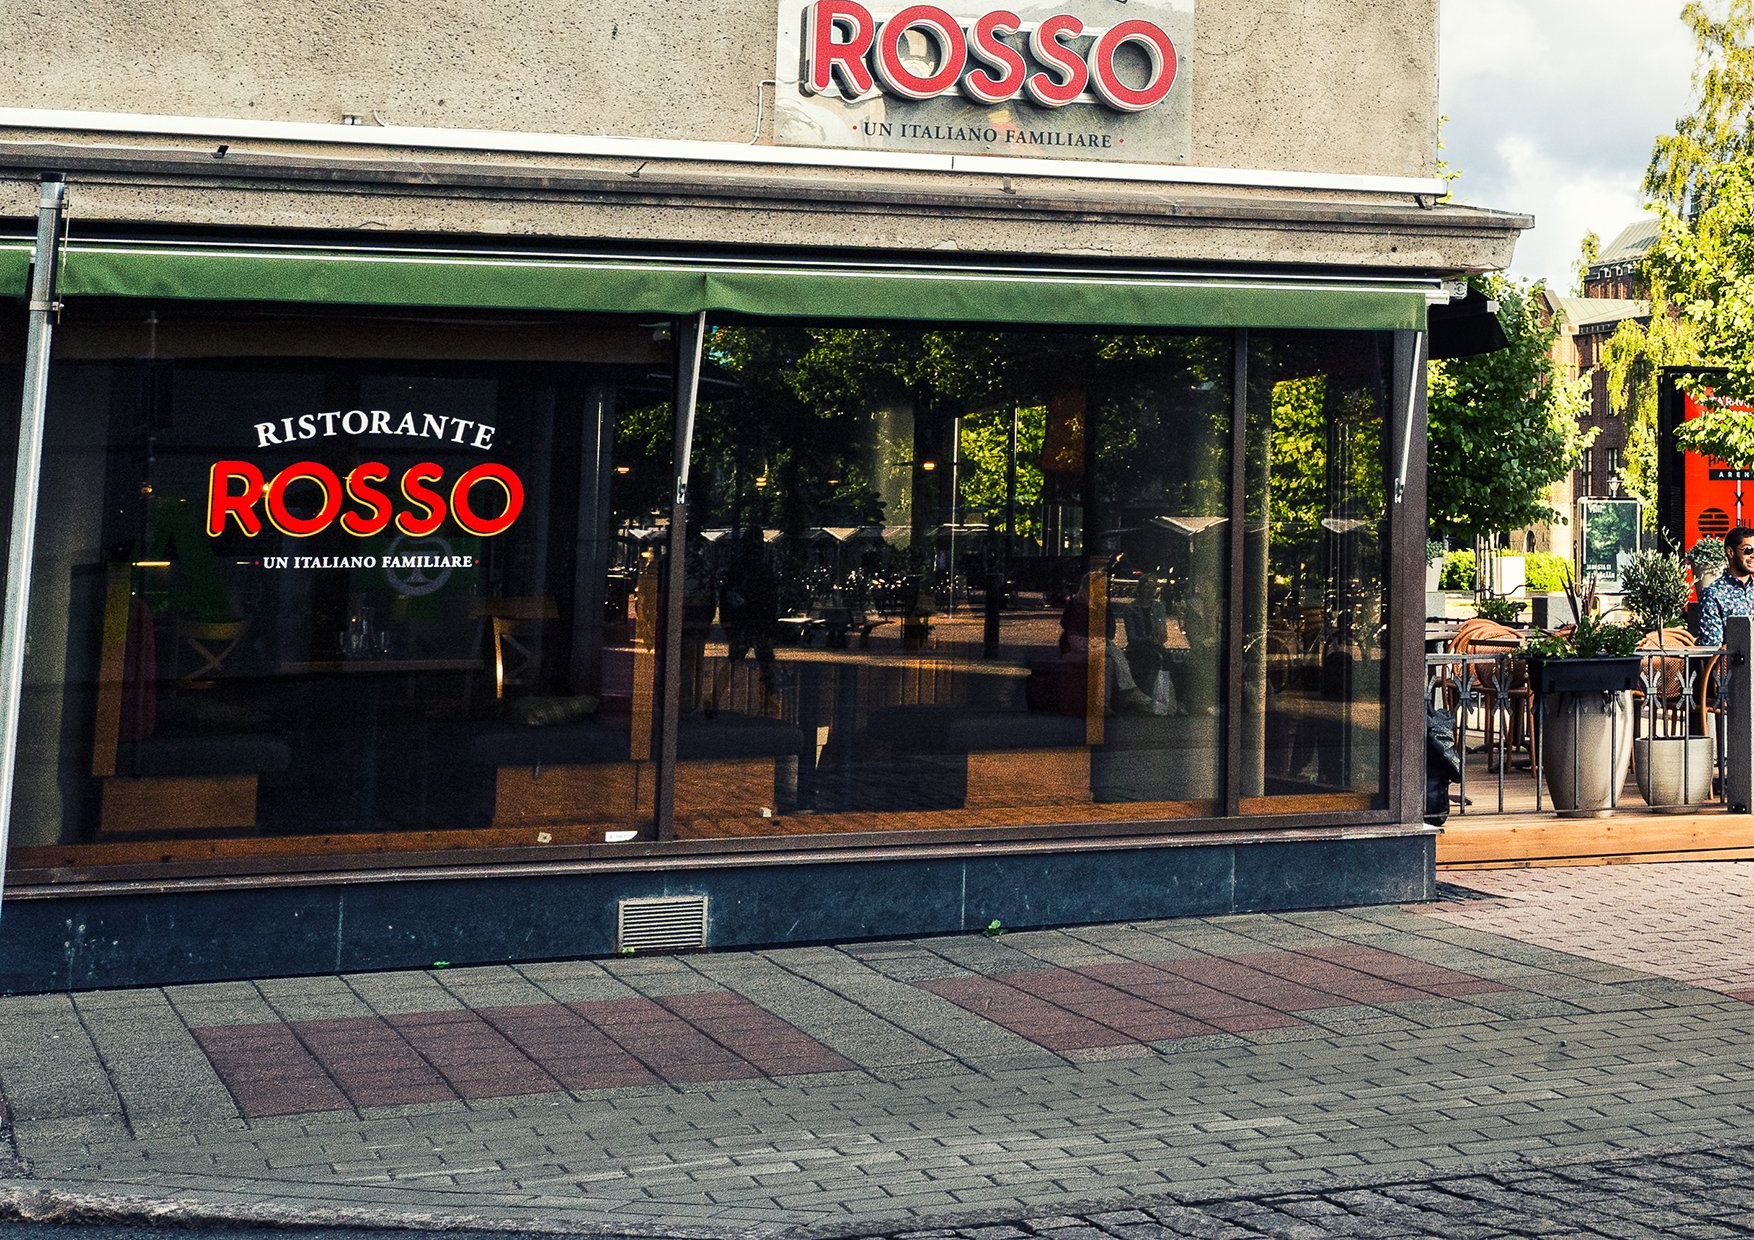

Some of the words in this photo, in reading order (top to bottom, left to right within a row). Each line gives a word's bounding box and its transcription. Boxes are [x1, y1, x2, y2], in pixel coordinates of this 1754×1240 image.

[863, 120, 894, 139] UN
[901, 122, 998, 144] ITALIANO
[1004, 127, 1113, 149] FAMILIARE
[253, 409, 496, 450] RISTORANTE
[206, 460, 525, 538] ROSSO
[263, 556, 290, 569] UN
[293, 556, 377, 569] ITALIANO
[381, 555, 474, 569] FAMILIARE
